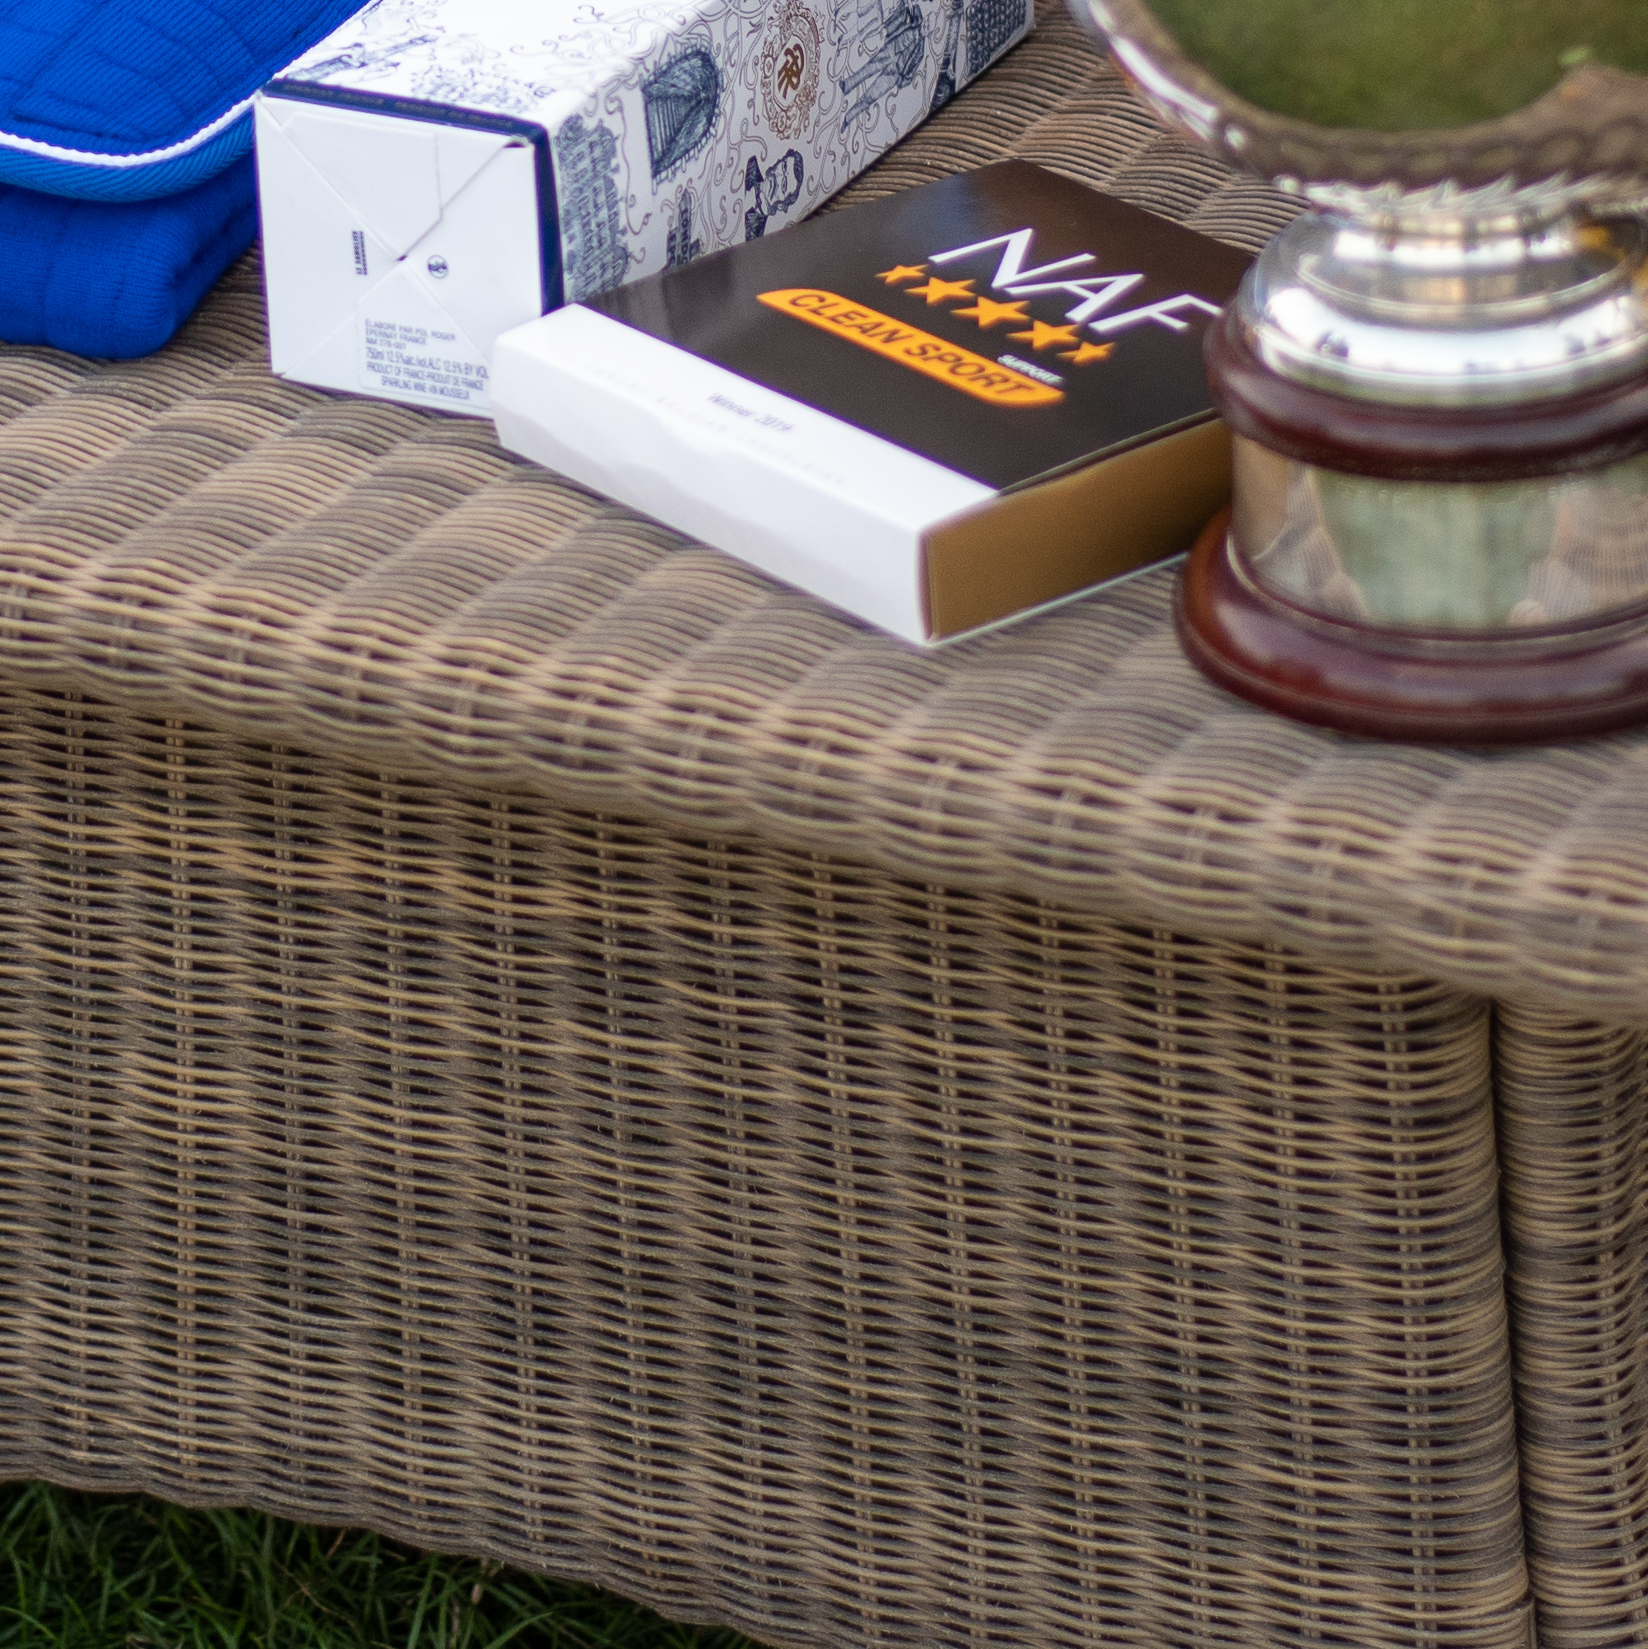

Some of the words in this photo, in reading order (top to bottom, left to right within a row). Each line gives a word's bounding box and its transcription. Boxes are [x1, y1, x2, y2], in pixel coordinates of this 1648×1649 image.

[926, 226, 1222, 336] NAF
[788, 293, 913, 344] CLEAN
[904, 342, 1036, 394] SPORT
[707, 391, 754, 418] Winner
